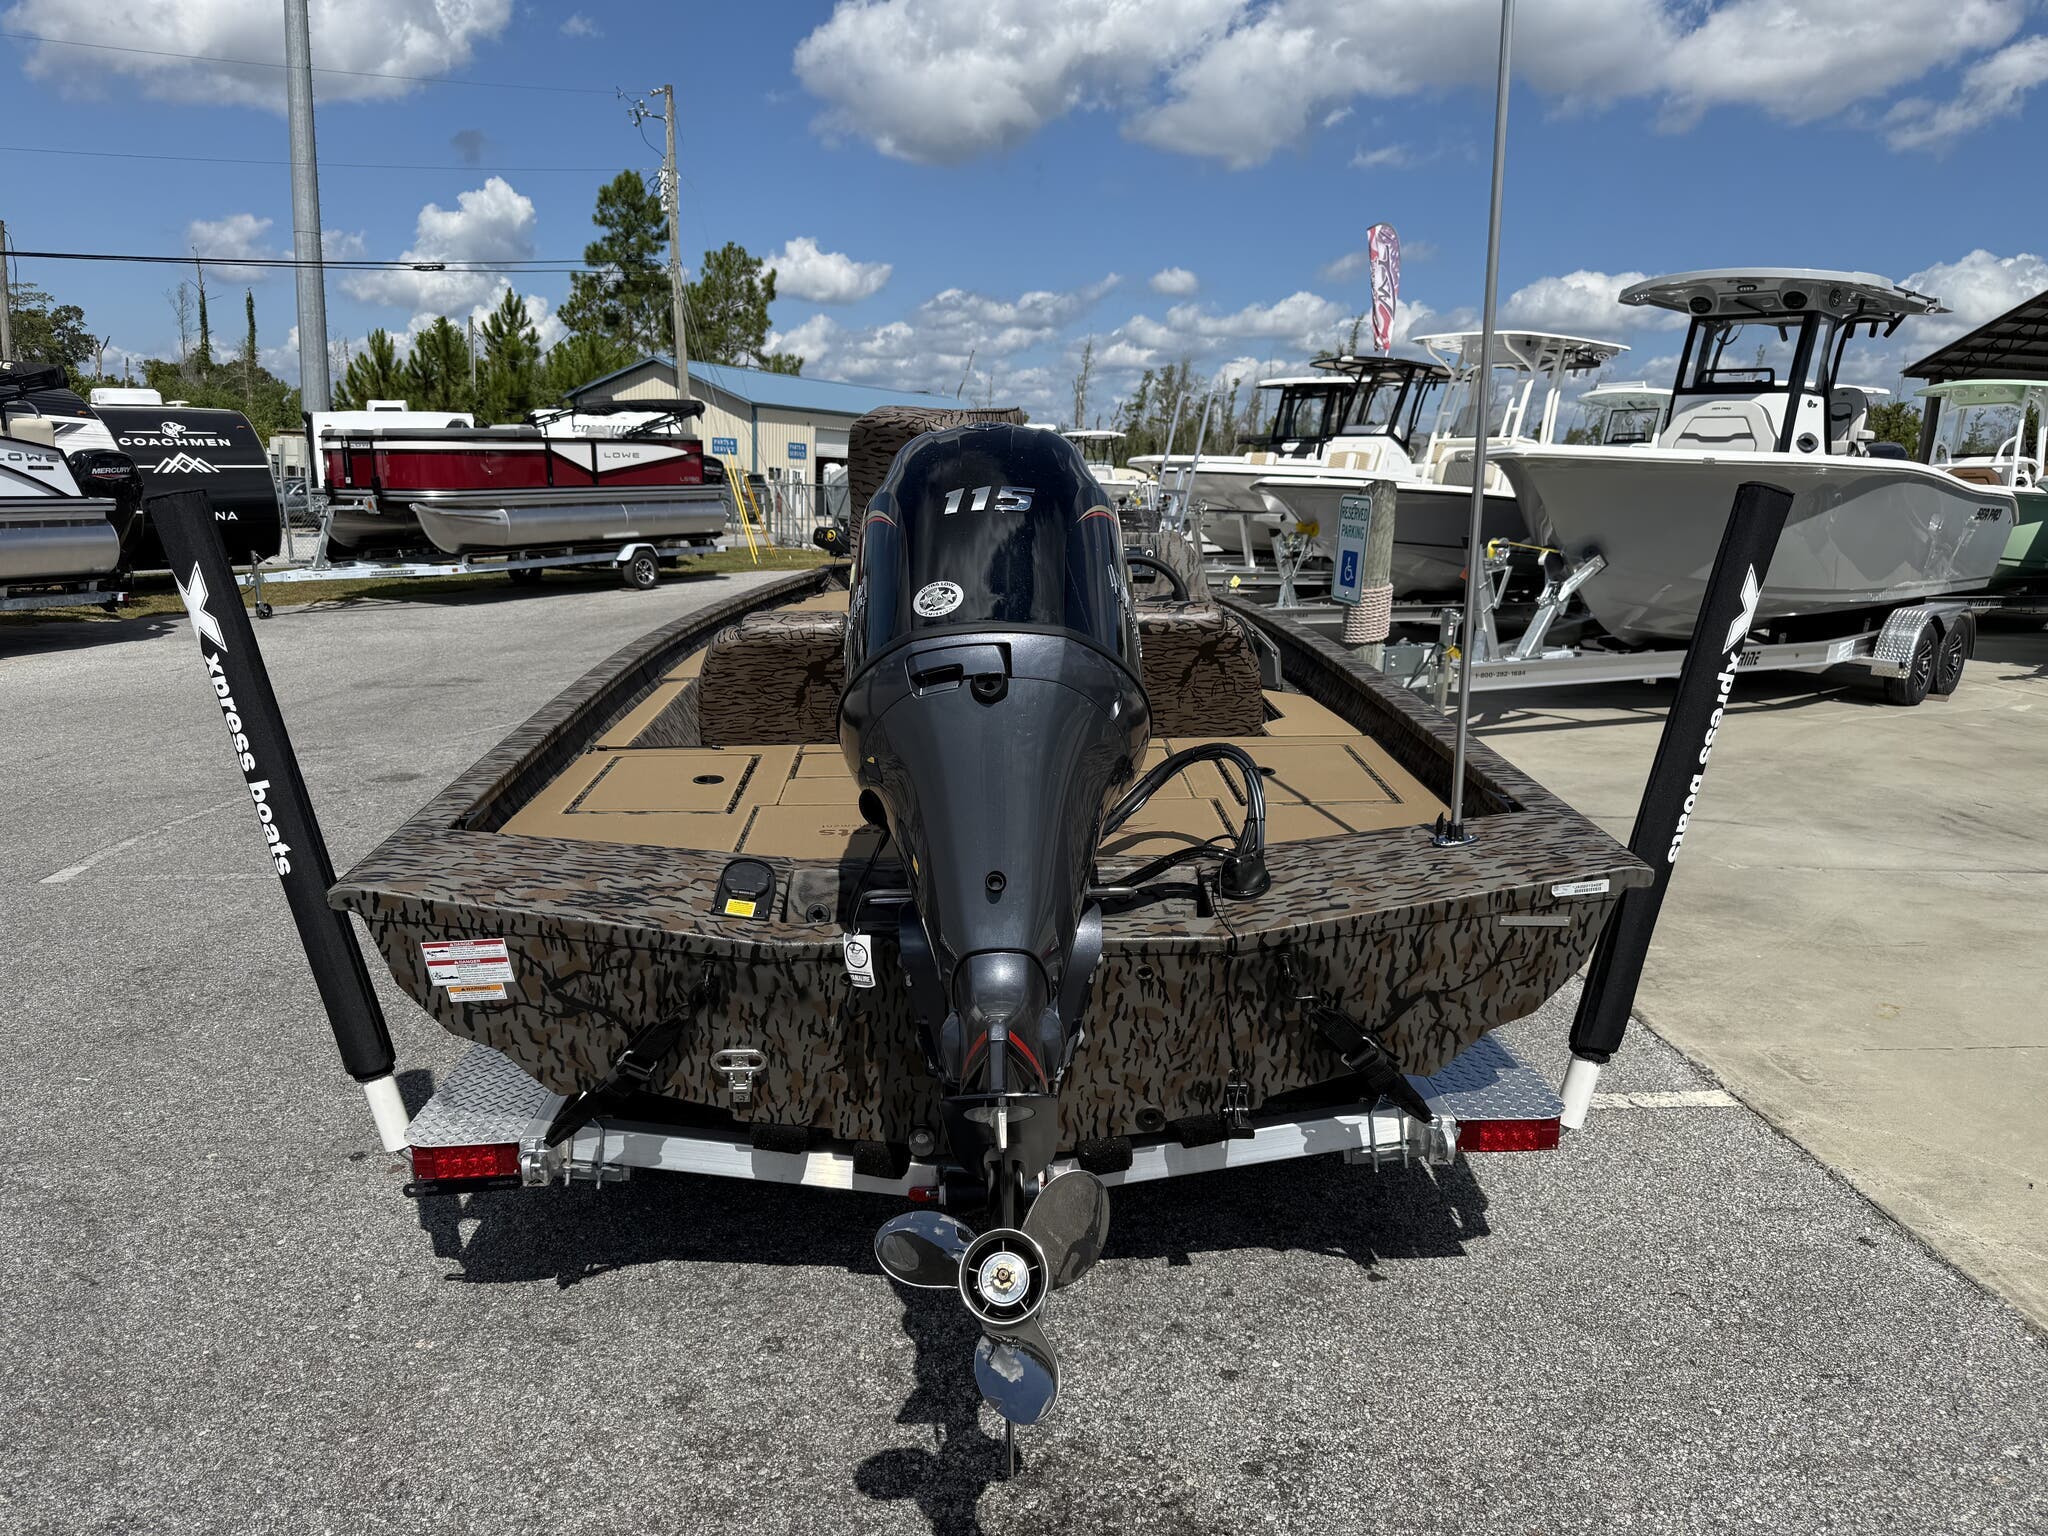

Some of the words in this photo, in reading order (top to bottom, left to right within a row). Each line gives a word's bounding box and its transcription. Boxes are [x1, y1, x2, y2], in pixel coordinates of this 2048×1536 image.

[118, 437, 232, 447] COACHMEN
[0, 452, 60, 463] OWE
[91, 465, 132, 475] MERCURY
[943, 485, 1036, 515] 115
[214, 511, 239, 521] NA
[1341, 506, 1368, 522] RESERVED
[1974, 508, 1990, 521] SEA
[1988, 508, 2003, 522] PRO
[1341, 524, 1365, 540] PARKING
[1737, 651, 1761, 667] RINE
[1698, 651, 1742, 765] xpress
[203, 652, 256, 772] xpress
[248, 779, 292, 876] boats
